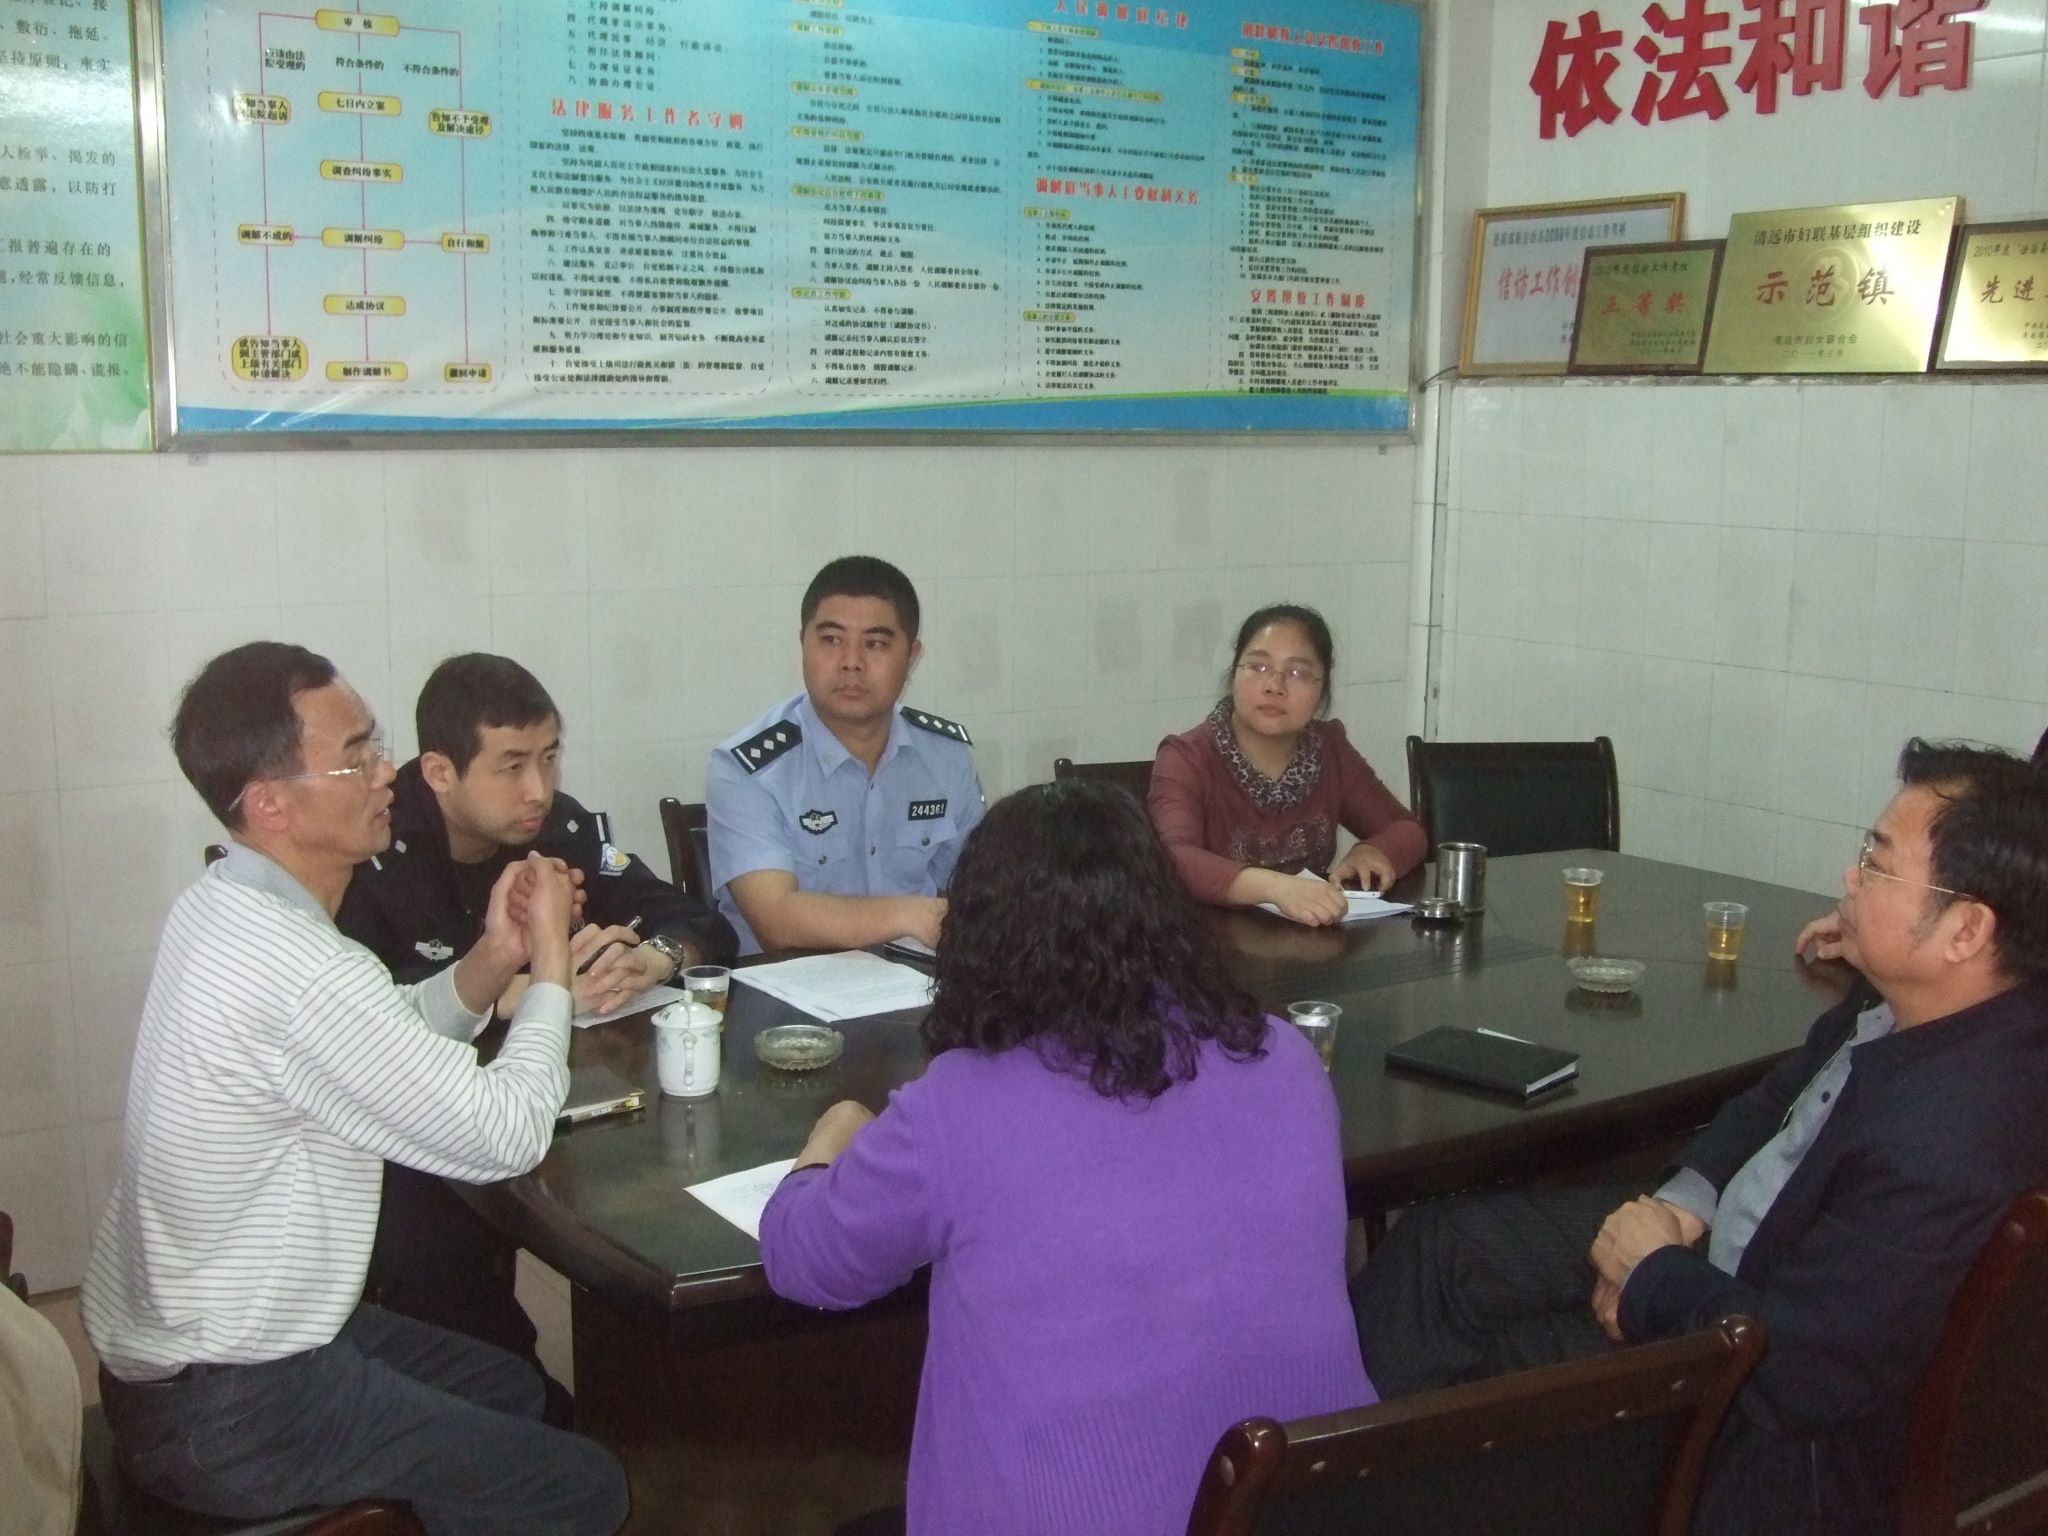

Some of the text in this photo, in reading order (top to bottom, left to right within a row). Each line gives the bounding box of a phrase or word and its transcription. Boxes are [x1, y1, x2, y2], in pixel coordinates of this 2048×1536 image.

[335, 56, 384, 71] 符合条件的
[402, 63, 459, 78] 不符合条件的
[1529, 0, 1988, 139] 依法和谐
[236, 96, 288, 110] 知当事人
[335, 97, 386, 111] 七日内立案
[551, 98, 744, 130] 法律服务工作者守则
[331, 165, 392, 179] 调查纠纷事实
[343, 233, 384, 245] 调解纠纷
[1753, 219, 1922, 246] 清远市妇联基层组织建设
[447, 238, 485, 249] 自行和解
[1756, 264, 1896, 308] 示范镇
[345, 300, 386, 311] 达成协议
[1601, 289, 1686, 318] 三等奖
[911, 803, 945, 817] 244361
